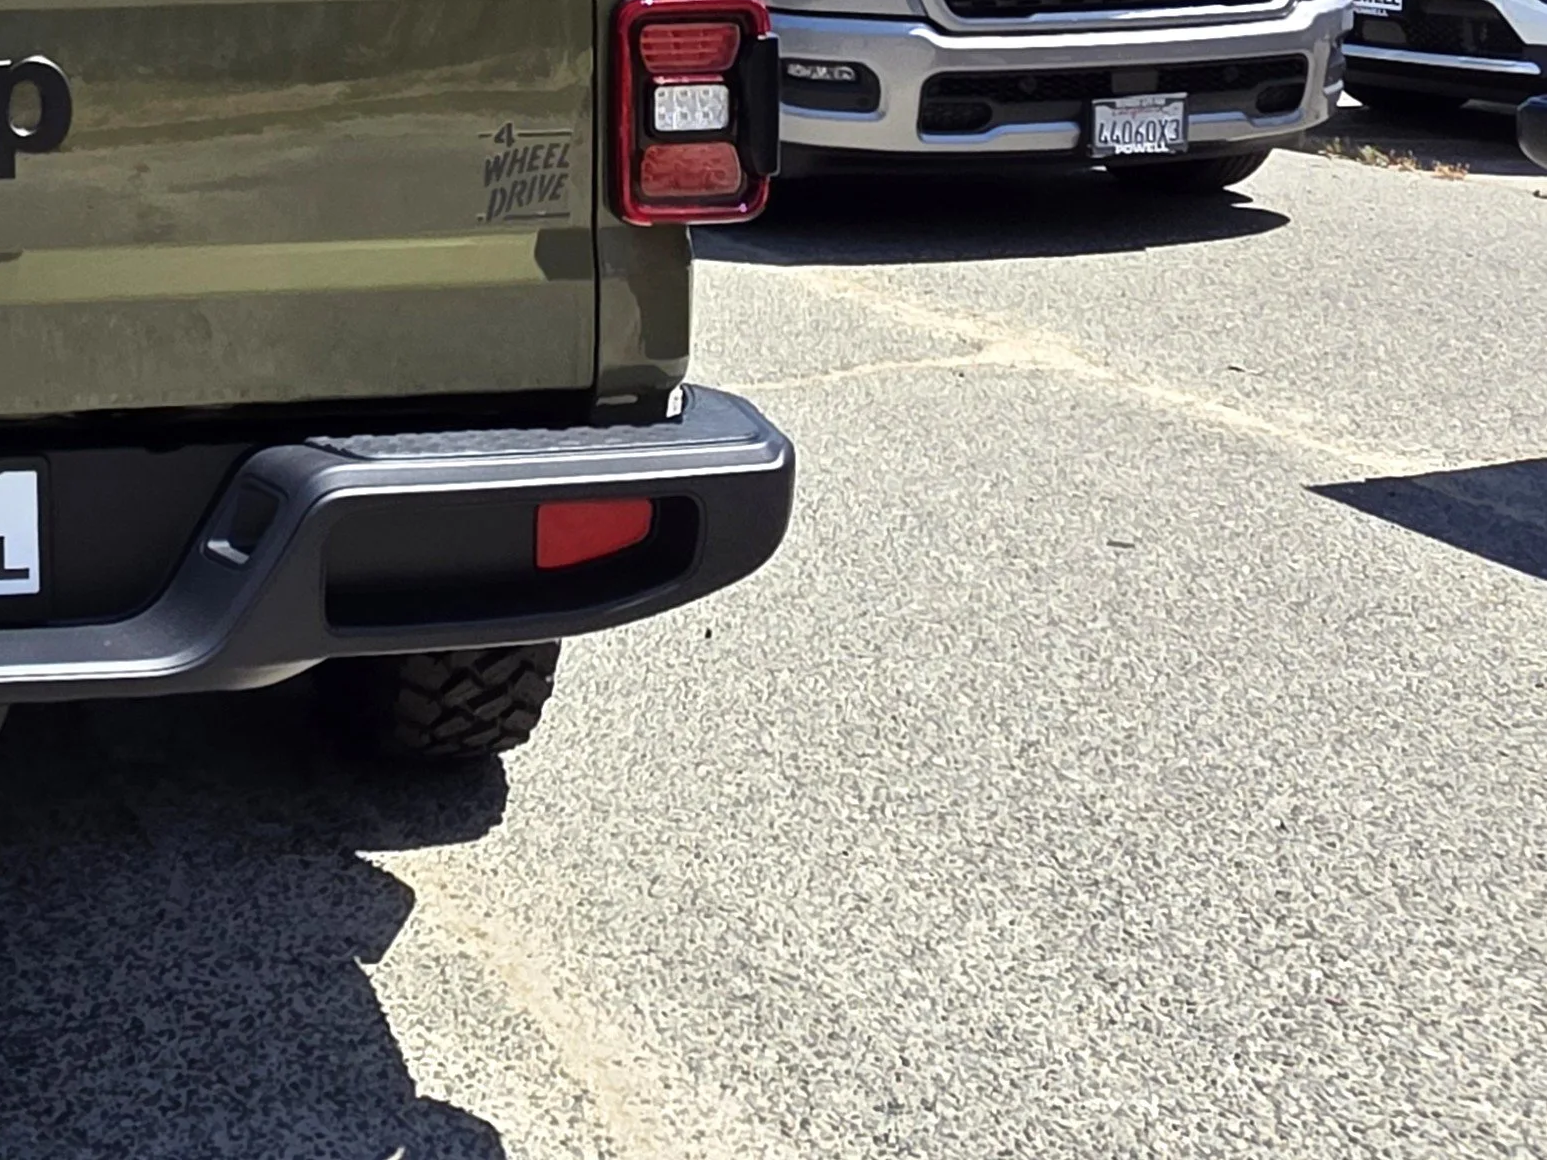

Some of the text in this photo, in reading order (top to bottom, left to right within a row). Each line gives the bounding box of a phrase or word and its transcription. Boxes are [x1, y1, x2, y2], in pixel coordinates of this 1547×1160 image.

[494, 122, 515, 148] 4
[483, 143, 570, 188] WHEEL
[485, 173, 569, 223] DRIVE
